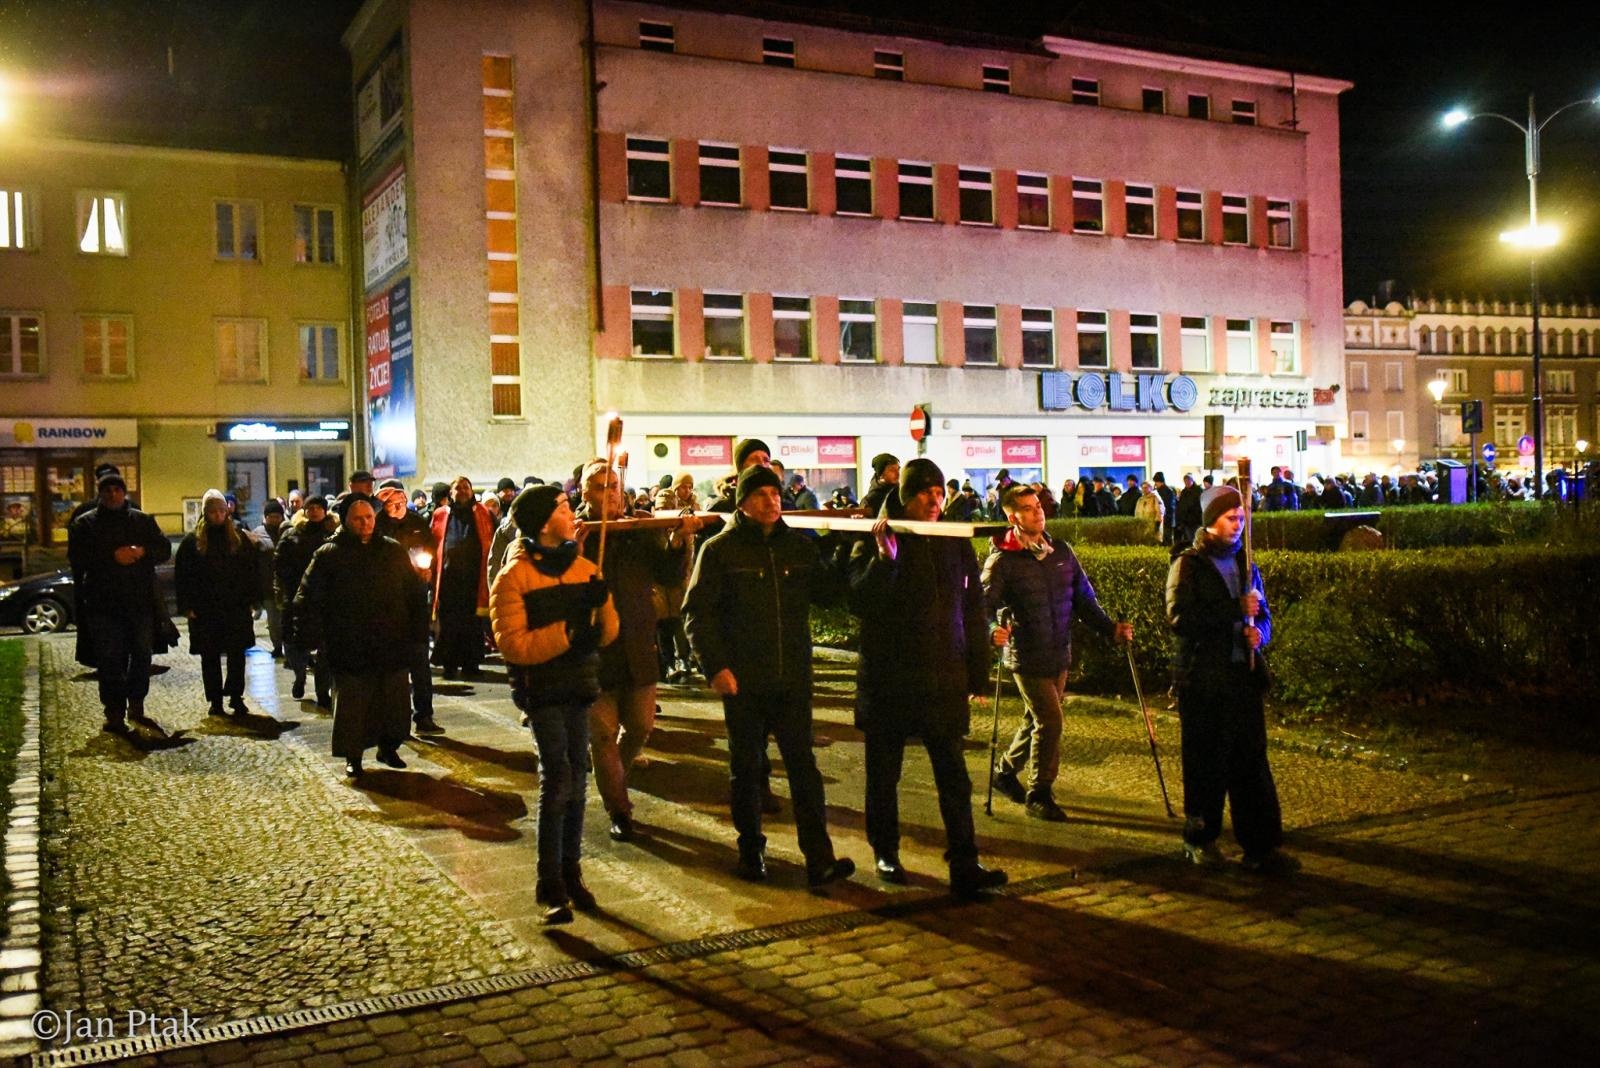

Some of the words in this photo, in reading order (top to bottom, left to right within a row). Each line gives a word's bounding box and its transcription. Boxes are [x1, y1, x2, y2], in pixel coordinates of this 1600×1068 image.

[1041, 370, 1198, 413] BOLKO
[1208, 386, 1309, 413] zaprasza
[38, 427, 106, 439] RAINBOW
